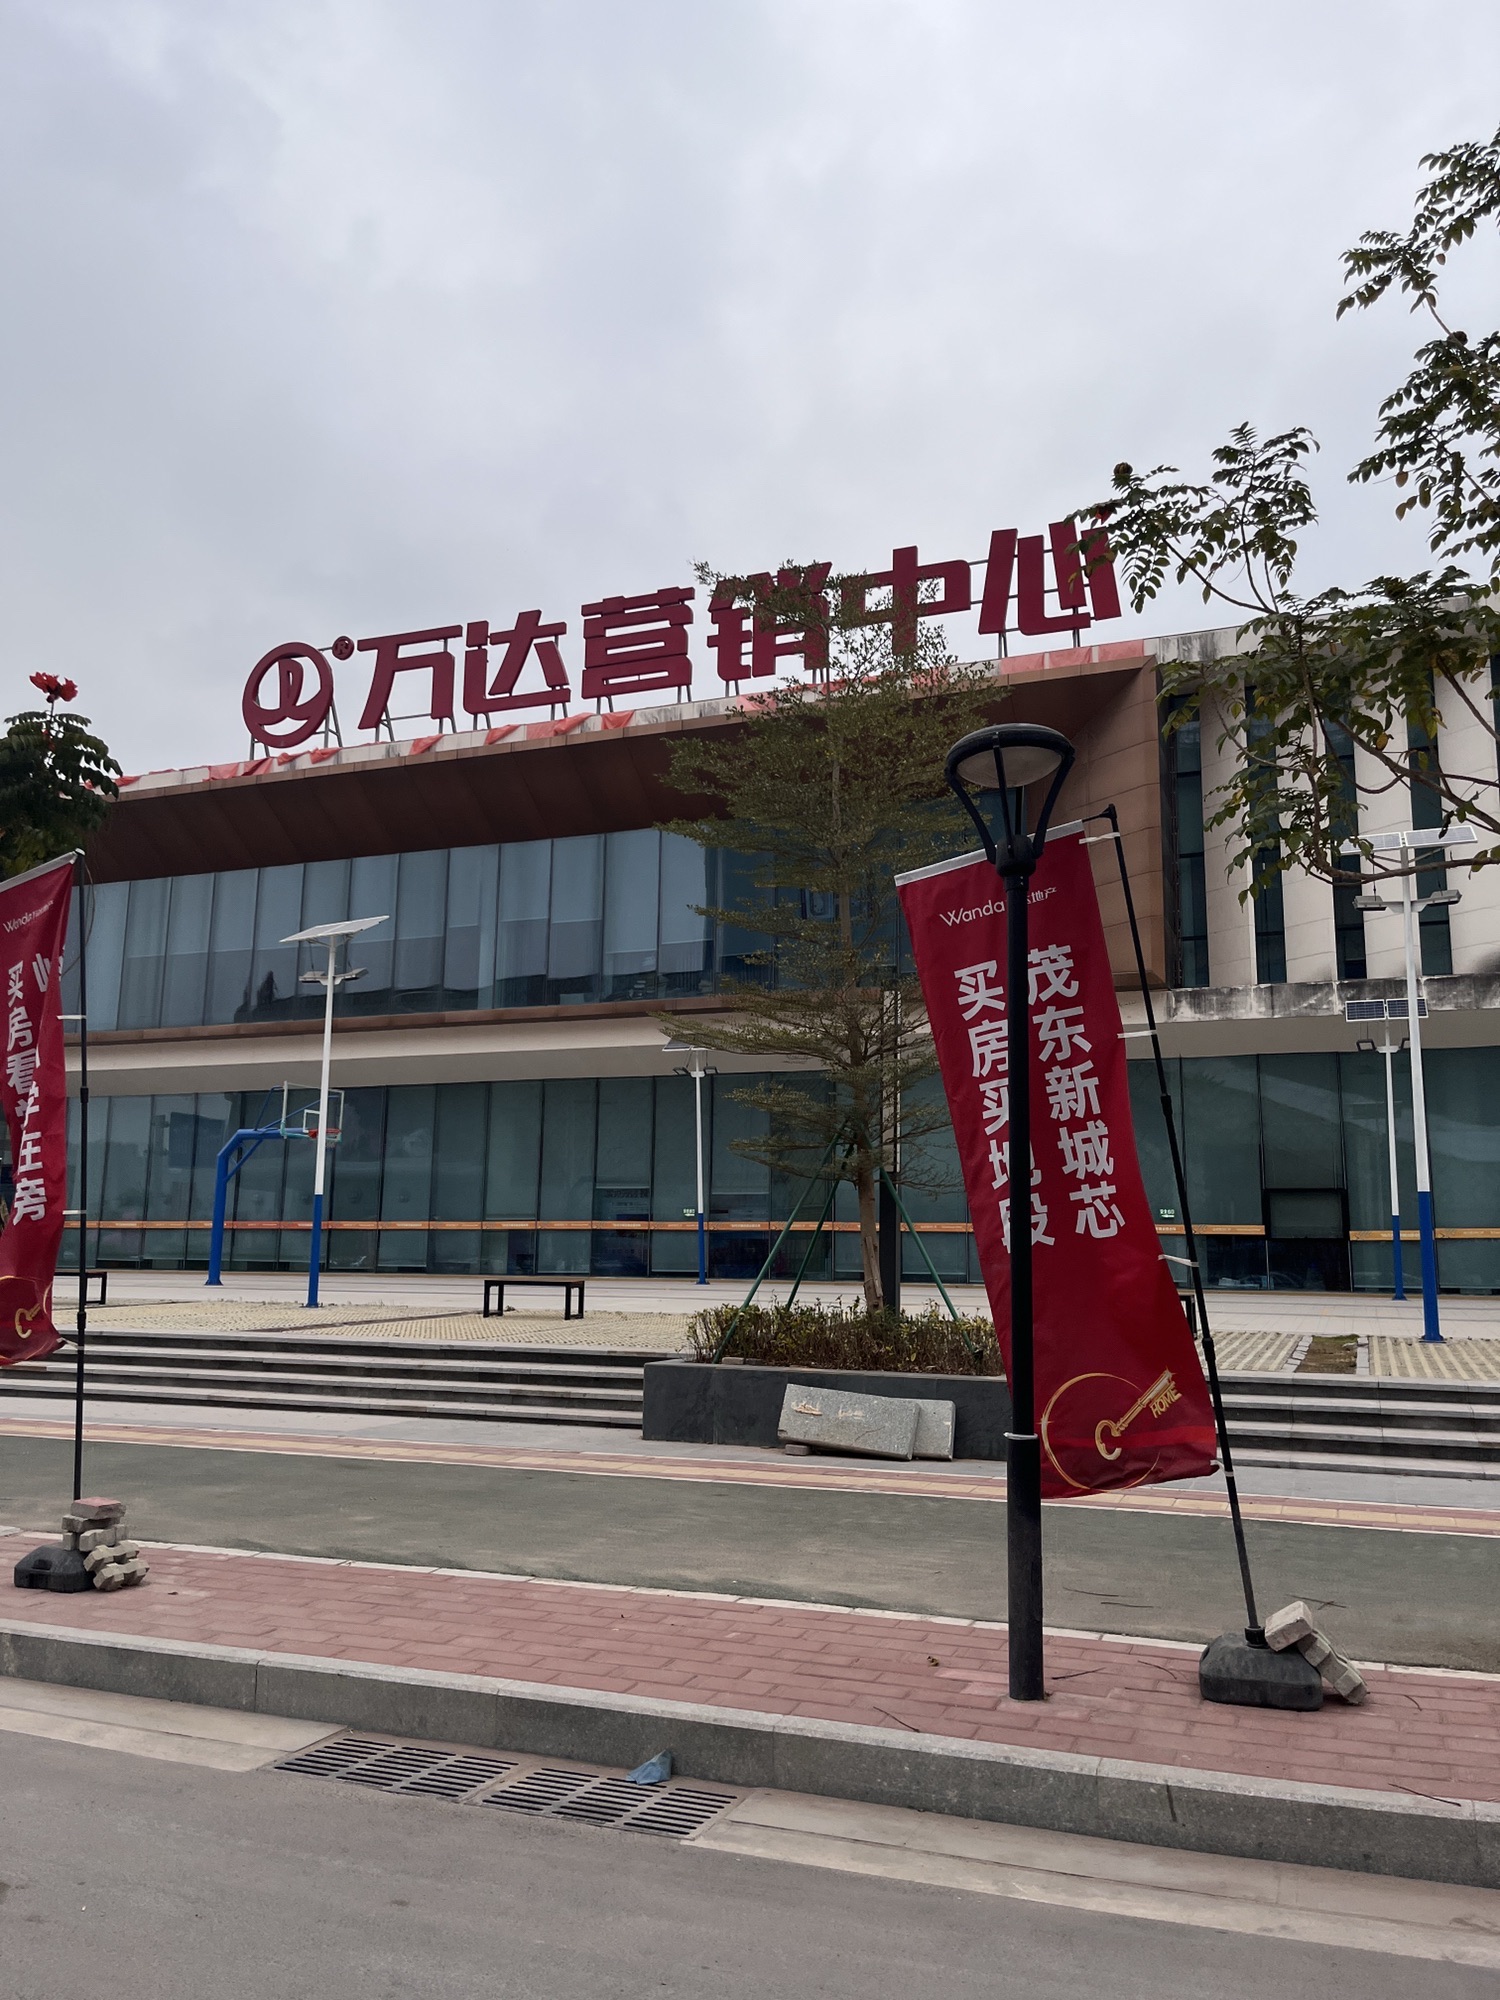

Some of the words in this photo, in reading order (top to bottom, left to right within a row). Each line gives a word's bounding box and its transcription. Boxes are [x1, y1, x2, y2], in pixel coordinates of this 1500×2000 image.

[357, 521, 1121, 730] 万达营销中心
[940, 900, 1006, 927] Wanda
[1028, 944, 1126, 1239] 茂东新城芯
[1150, 1381, 1182, 1419] HOME
